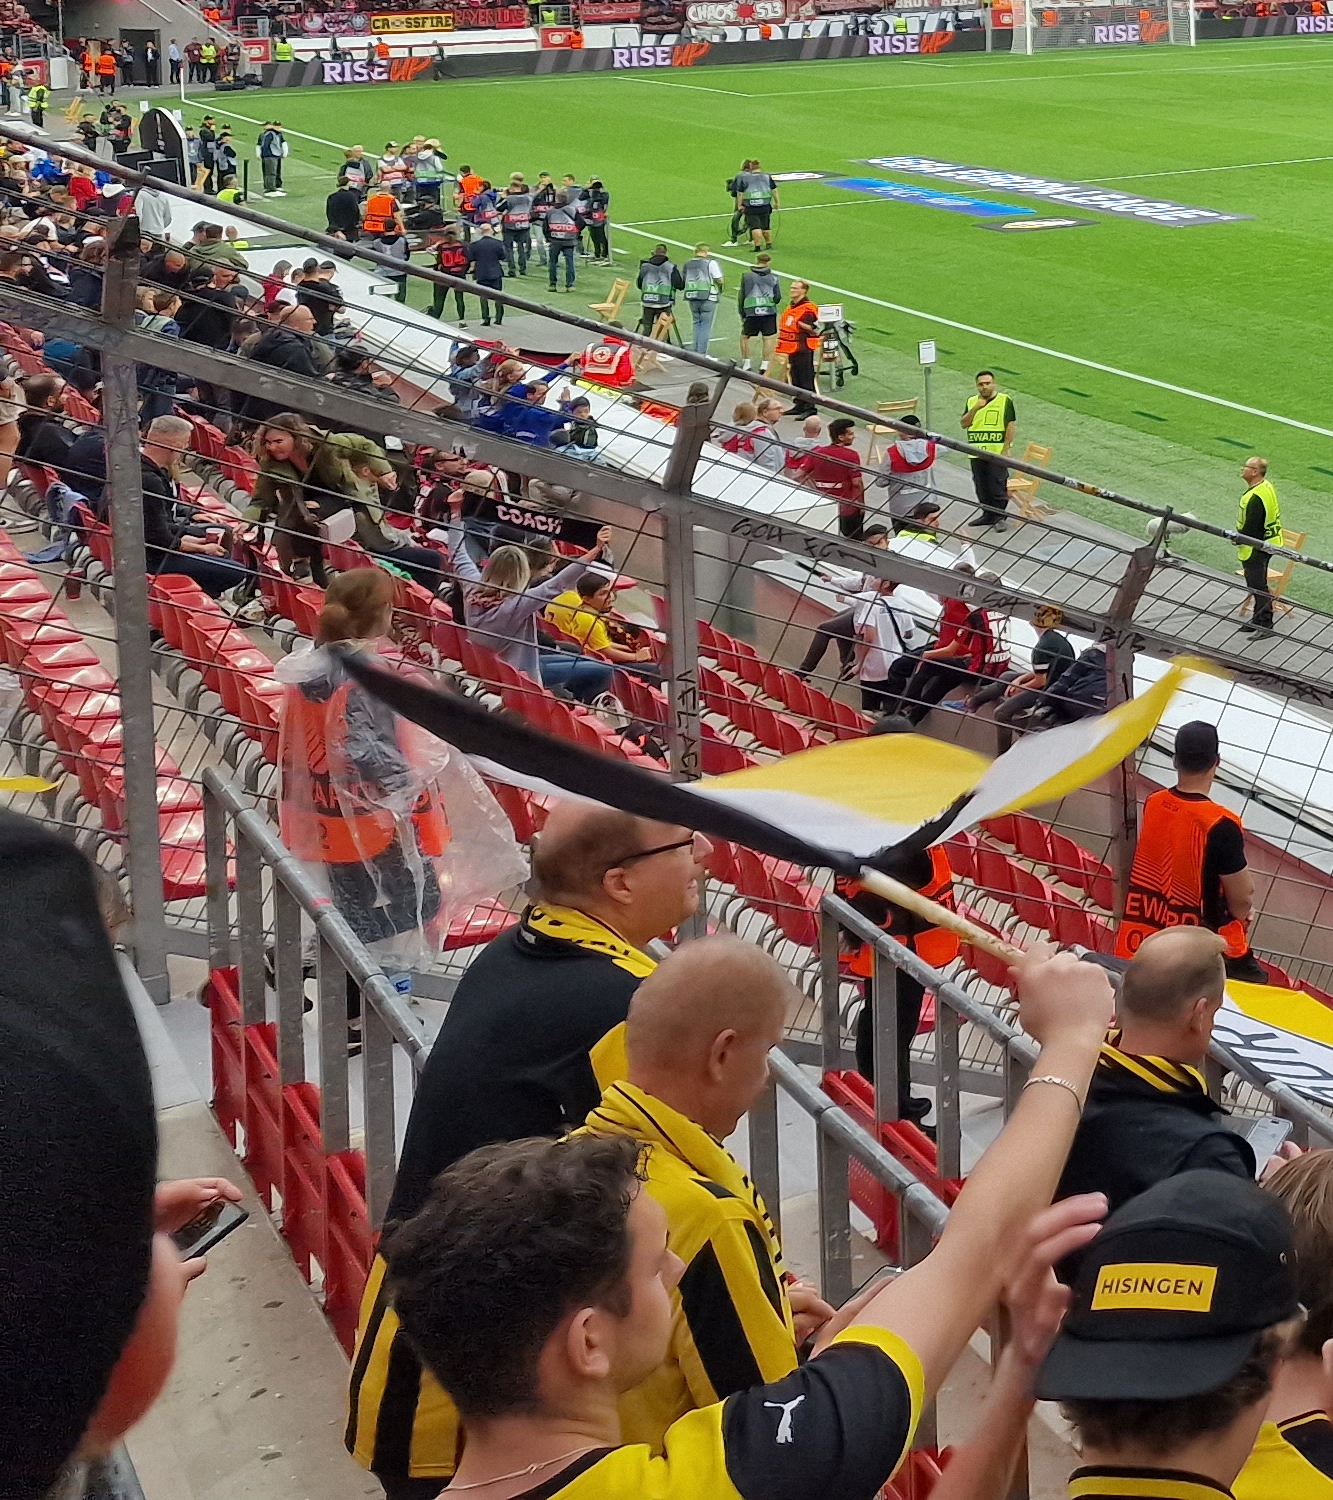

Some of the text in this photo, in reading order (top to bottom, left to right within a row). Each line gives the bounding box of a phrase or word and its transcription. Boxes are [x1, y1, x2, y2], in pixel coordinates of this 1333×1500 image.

[688, 1, 781, 21] CHAOS 513
[869, 31, 956, 54] RISE UP
[1094, 21, 1171, 43] RISE UP
[613, 43, 711, 68] RISE UP
[322, 56, 434, 84] RISE UP
[1049, 190, 1220, 222] LEAGUE
[1100, 1277, 1204, 1296] HISINGEN
